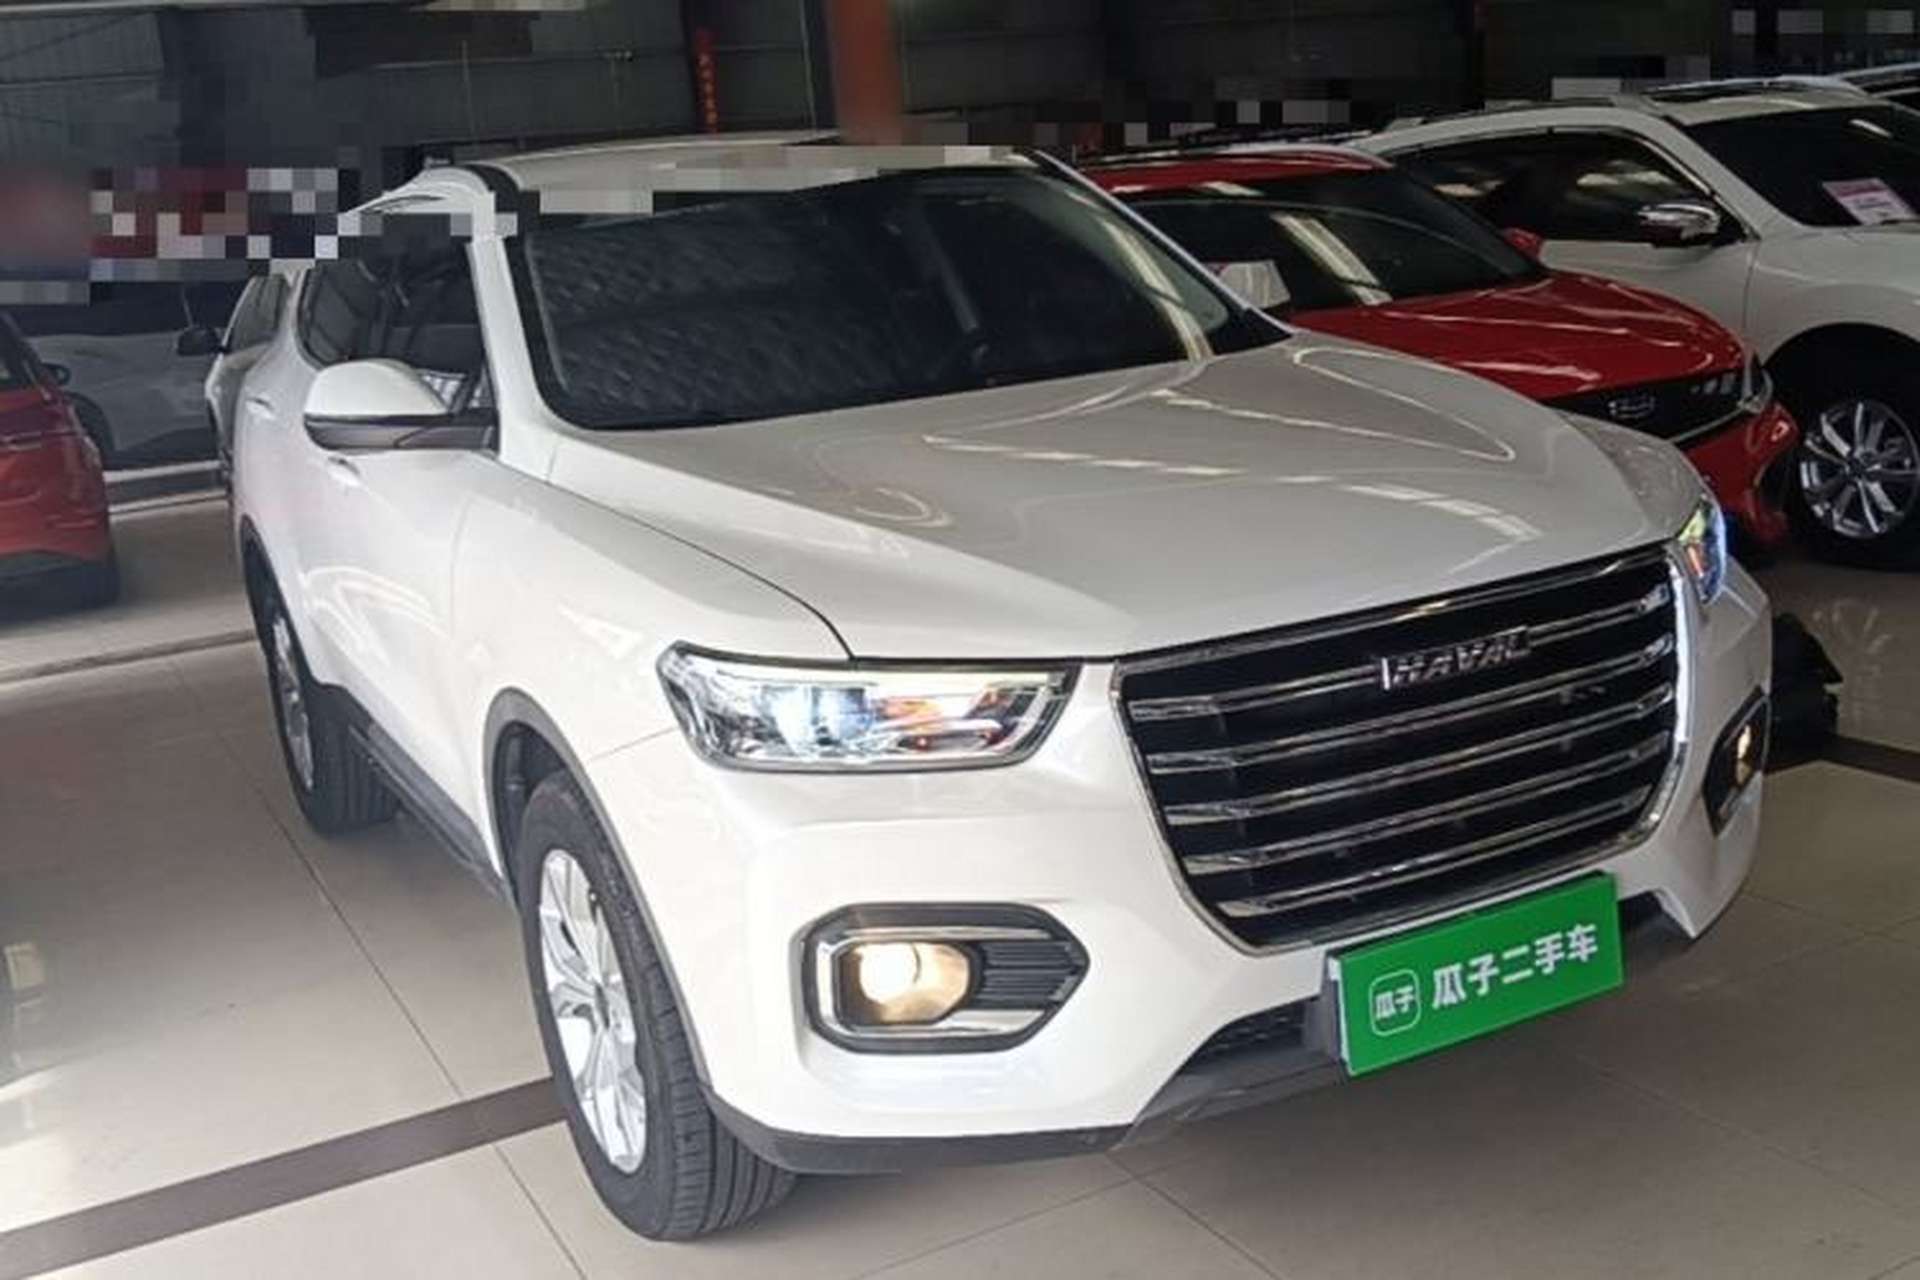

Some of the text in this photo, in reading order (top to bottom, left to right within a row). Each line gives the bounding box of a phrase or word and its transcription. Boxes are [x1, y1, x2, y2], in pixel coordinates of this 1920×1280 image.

[1380, 630, 1533, 691] HAVAL
[1432, 923, 1598, 1010] 瓜子二手车
[1374, 985, 1415, 1020] 瓜子
